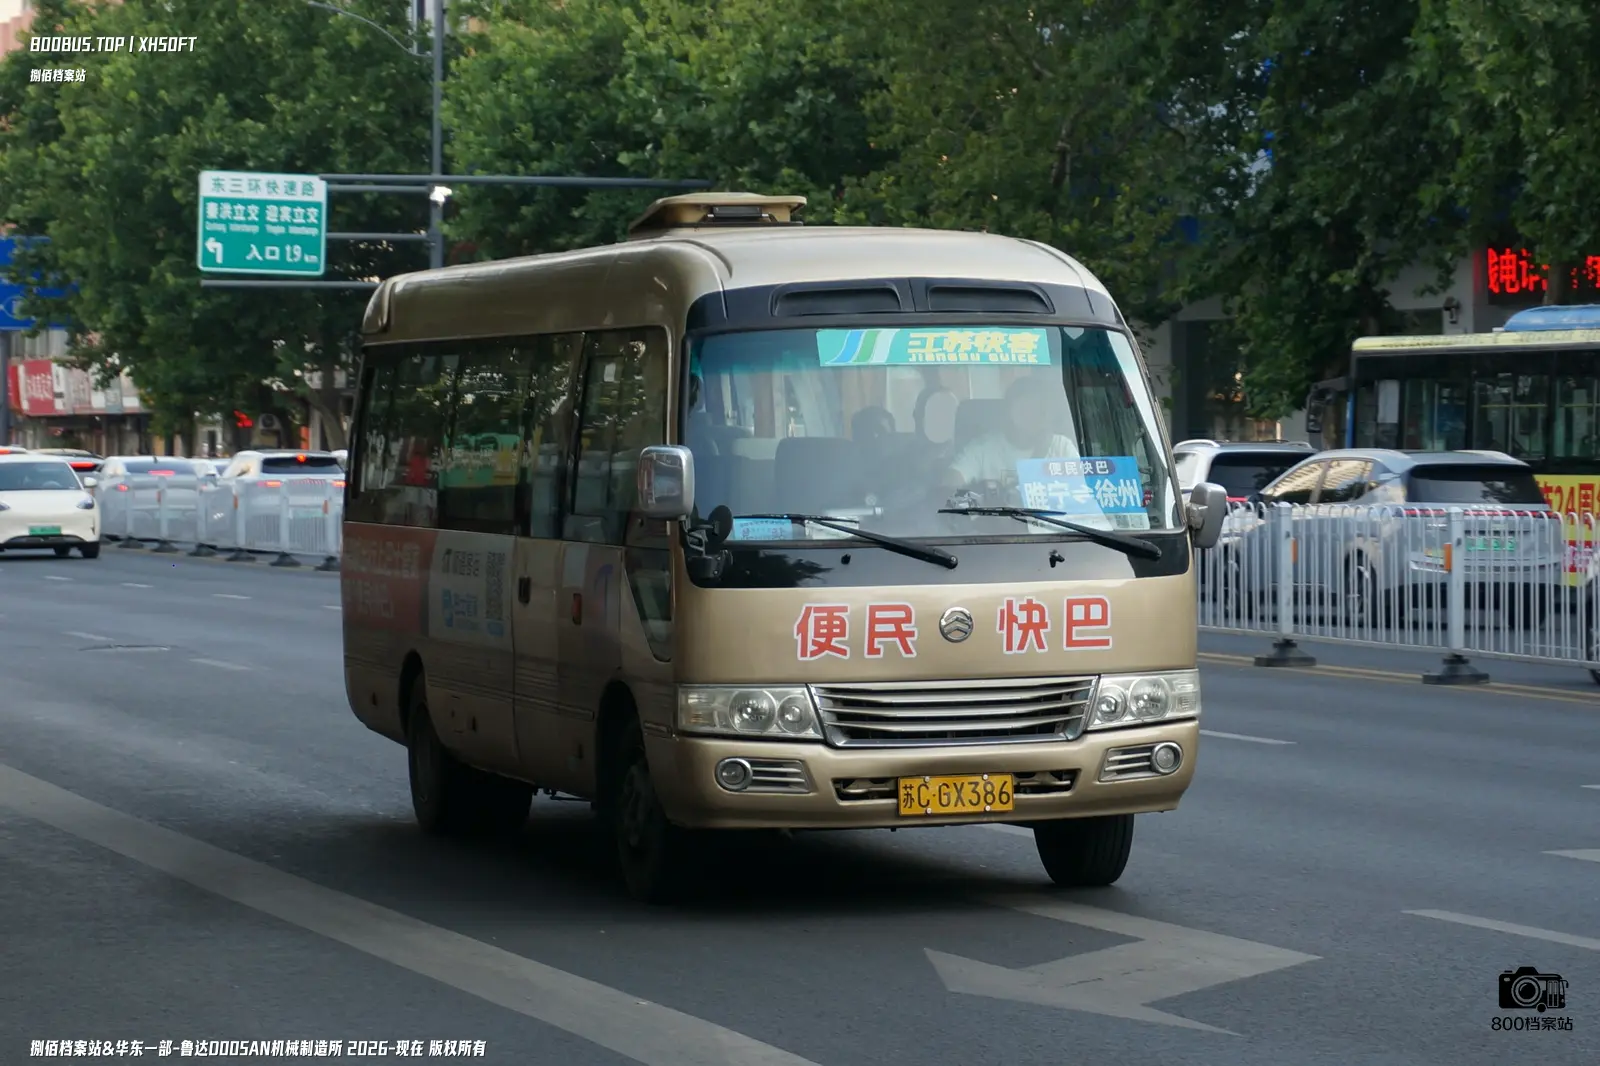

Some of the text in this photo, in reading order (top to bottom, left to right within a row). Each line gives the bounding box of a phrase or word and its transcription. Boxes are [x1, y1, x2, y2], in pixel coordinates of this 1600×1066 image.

[210, 175, 316, 197] 东三环快速路
[245, 243, 280, 261] 入口
[907, 331, 1041, 353] 江苏快客
[1048, 460, 1109, 475] 便民快巴
[1094, 478, 1142, 508] 徐州
